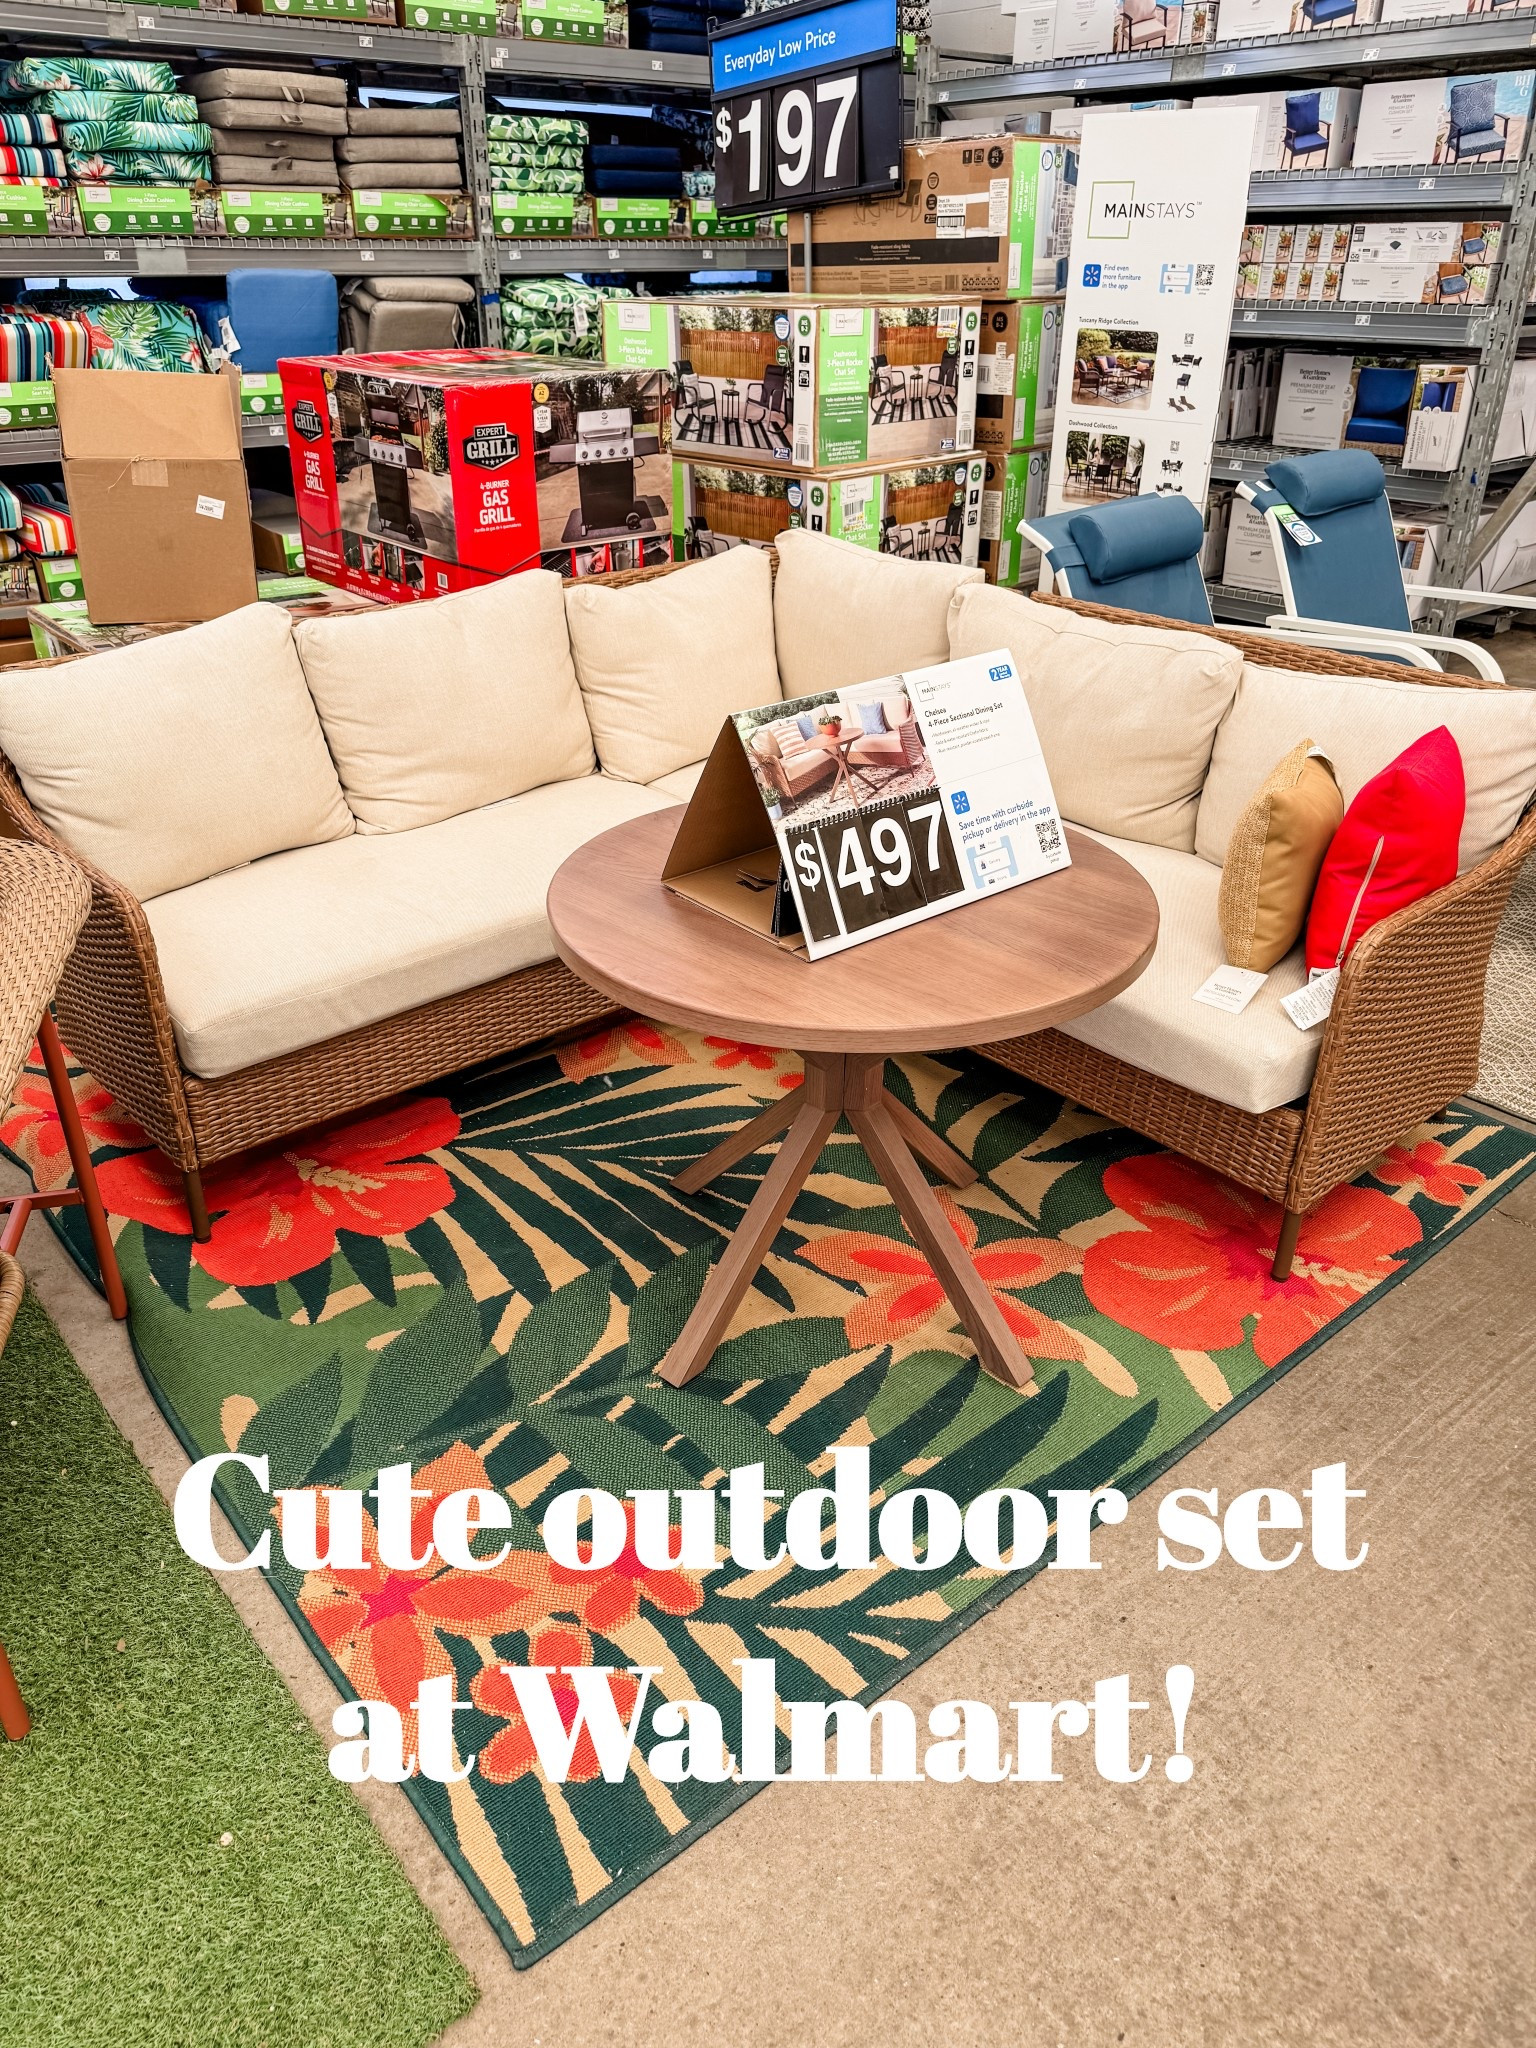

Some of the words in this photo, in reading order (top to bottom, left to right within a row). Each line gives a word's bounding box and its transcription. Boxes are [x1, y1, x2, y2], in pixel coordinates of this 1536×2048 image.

[724, 45, 775, 73] Everyday
[778, 39, 802, 59] Low
[805, 28, 837, 51] Price
[715, 75, 858, 193] $197
[1103, 264, 1116, 272] Find
[1117, 273, 1142, 281] furniture
[1079, 317, 1098, 325] Tuscany
[1098, 317, 1113, 325] Ridge
[1113, 318, 1139, 326] Collection
[624, 337, 647, 346] Dashwood
[618, 345, 636, 354] 3-Piece
[635, 346, 653, 356] Rocker
[833, 350, 858, 358] Dashwood
[625, 354, 637, 363] Chat
[637, 355, 647, 364] Set
[826, 359, 845, 368] 3-Piece
[845, 358, 864, 366] Rocker
[834, 368, 847, 377] Chat
[847, 367, 856, 376] Set
[1299, 368, 1315, 376] Better
[1315, 369, 1331, 377] Homes
[298, 402, 313, 412] EXPERT
[294, 413, 322, 432] GRILL
[1069, 420, 1093, 428] Dashwood
[1093, 421, 1118, 430] Collection
[476, 425, 504, 437] EXPERT
[941, 439, 947, 448] 2
[466, 439, 517, 460] GRILL
[775, 448, 781, 458] 2
[305, 459, 321, 476] GAS
[305, 475, 325, 492] GRILL
[480, 479, 510, 490] 4-BURNER
[482, 489, 510, 508] GAS
[479, 506, 516, 526] GRILL
[1236, 525, 1258, 533] PREMIUM
[845, 533, 857, 541] Chat
[857, 531, 867, 541] Set
[1243, 531, 1265, 539] CUSHION
[990, 669, 998, 681] 2
[924, 707, 947, 718] Chelsea
[928, 717, 950, 728] 4-Piece
[950, 710, 975, 722] Sectional
[975, 705, 994, 716] Dining
[993, 701, 1004, 710] Set
[958, 821, 975, 831] Save
[975, 815, 991, 826] time
[991, 809, 1007, 819] with
[1006, 799, 1034, 815] curbside
[962, 829, 985, 844] pickup
[985, 825, 992, 834] or
[993, 816, 1019, 832] delivery
[1019, 813, 1027, 822] in
[1027, 809, 1038, 819] the
[1038, 806, 1051, 818] app
[794, 800, 943, 896] $497
